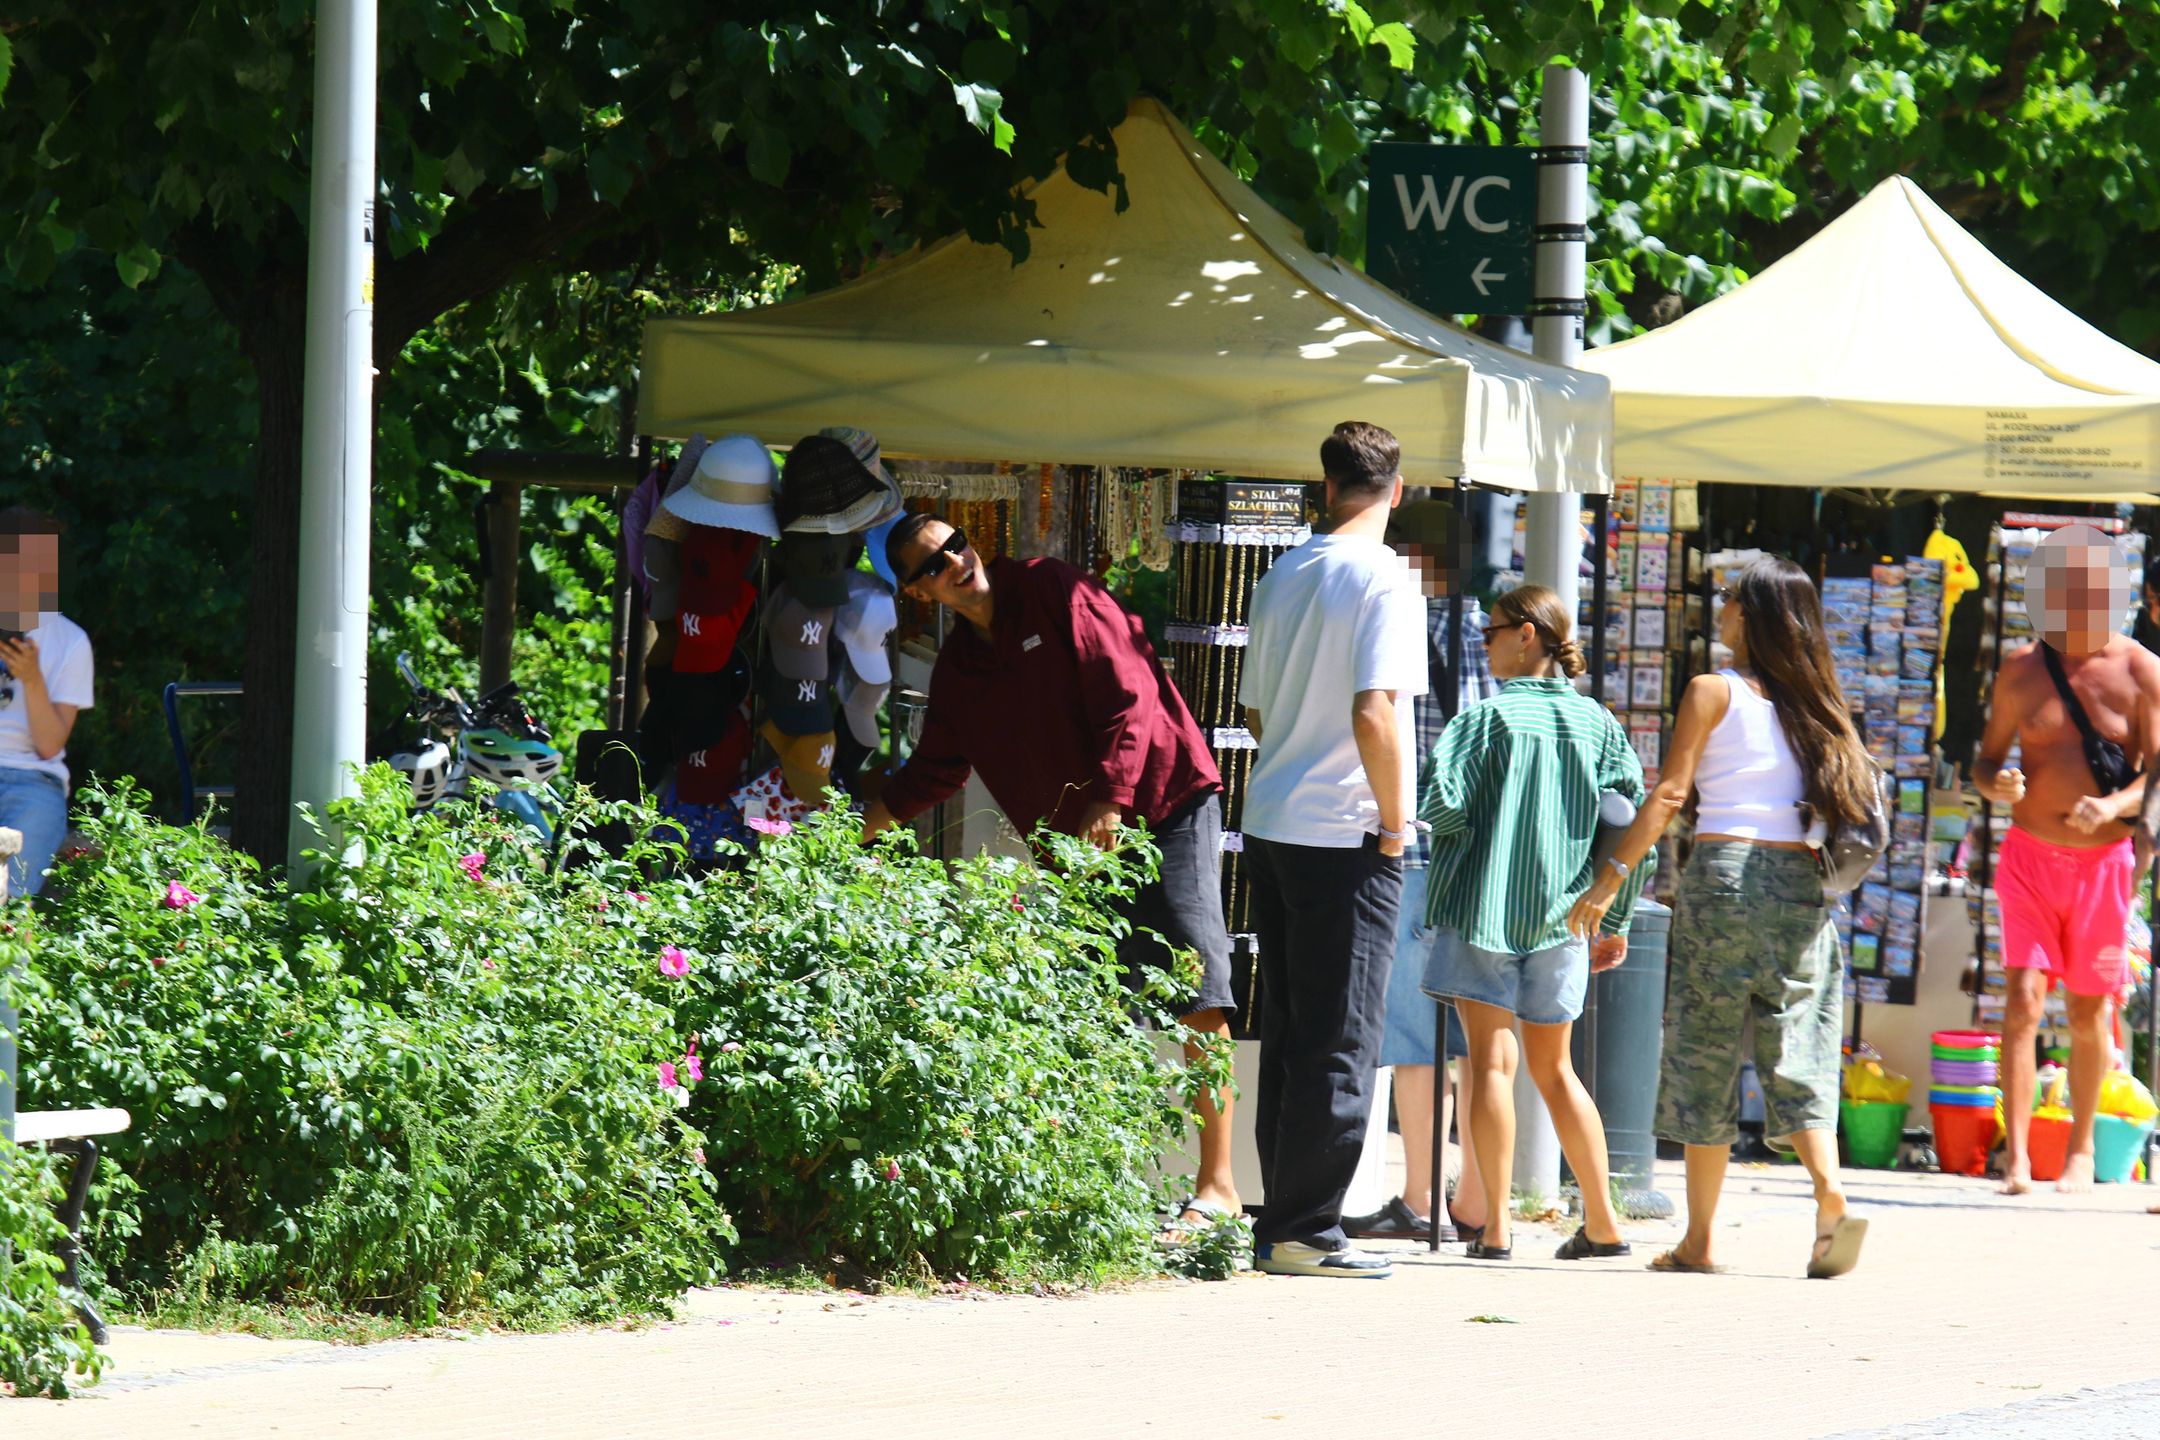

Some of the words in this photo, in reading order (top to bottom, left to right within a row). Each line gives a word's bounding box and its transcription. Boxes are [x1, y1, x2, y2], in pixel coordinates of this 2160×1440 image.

[1393, 174, 1511, 233] WC
[1251, 490, 1279, 500] STAL
[1228, 500, 1301, 512] SZLACHETNA
[800, 619, 823, 646] NY
